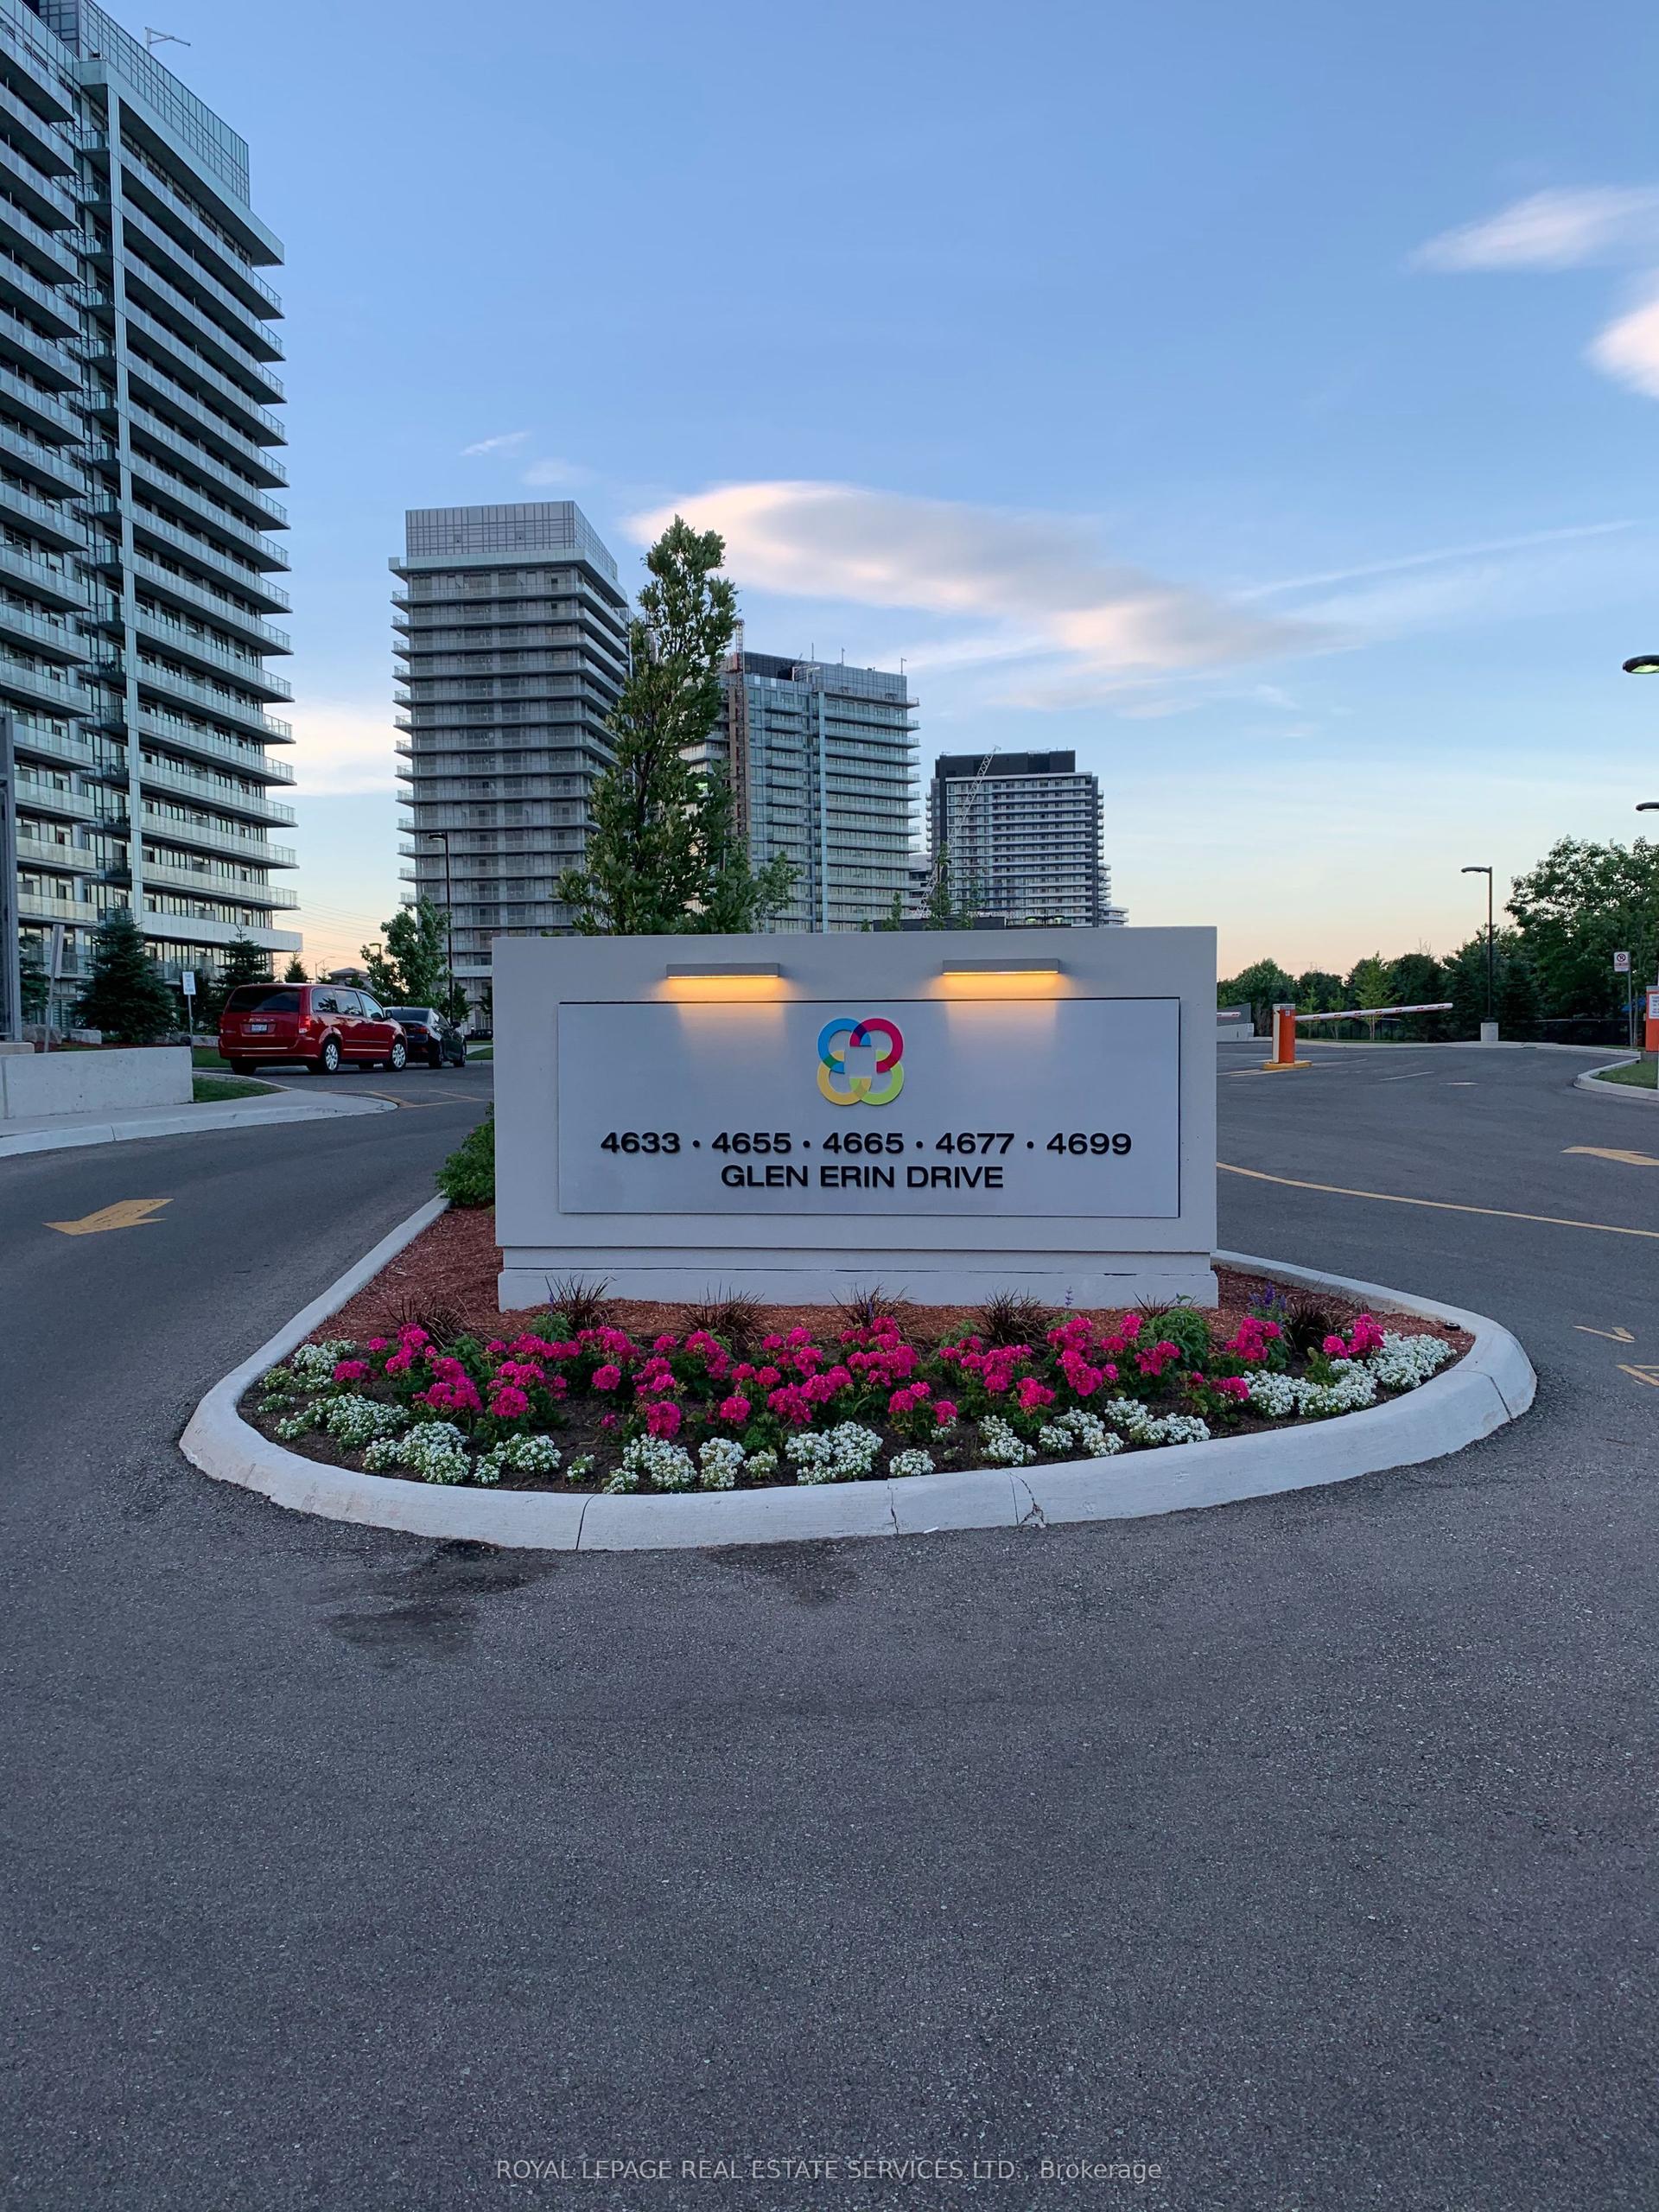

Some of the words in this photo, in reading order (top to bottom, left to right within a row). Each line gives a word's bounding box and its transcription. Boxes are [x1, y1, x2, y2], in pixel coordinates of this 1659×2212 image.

[600, 1131, 682, 1155] 4633
[711, 1131, 792, 1155] 4655
[822, 1132, 905, 1155] 4665
[935, 1132, 1015, 1155] 4677
[1046, 1132, 1132, 1156] 4699
[721, 1164, 809, 1189] GLEN
[820, 1165, 895, 1190] ERIN
[906, 1166, 1004, 1190] DRIVE
